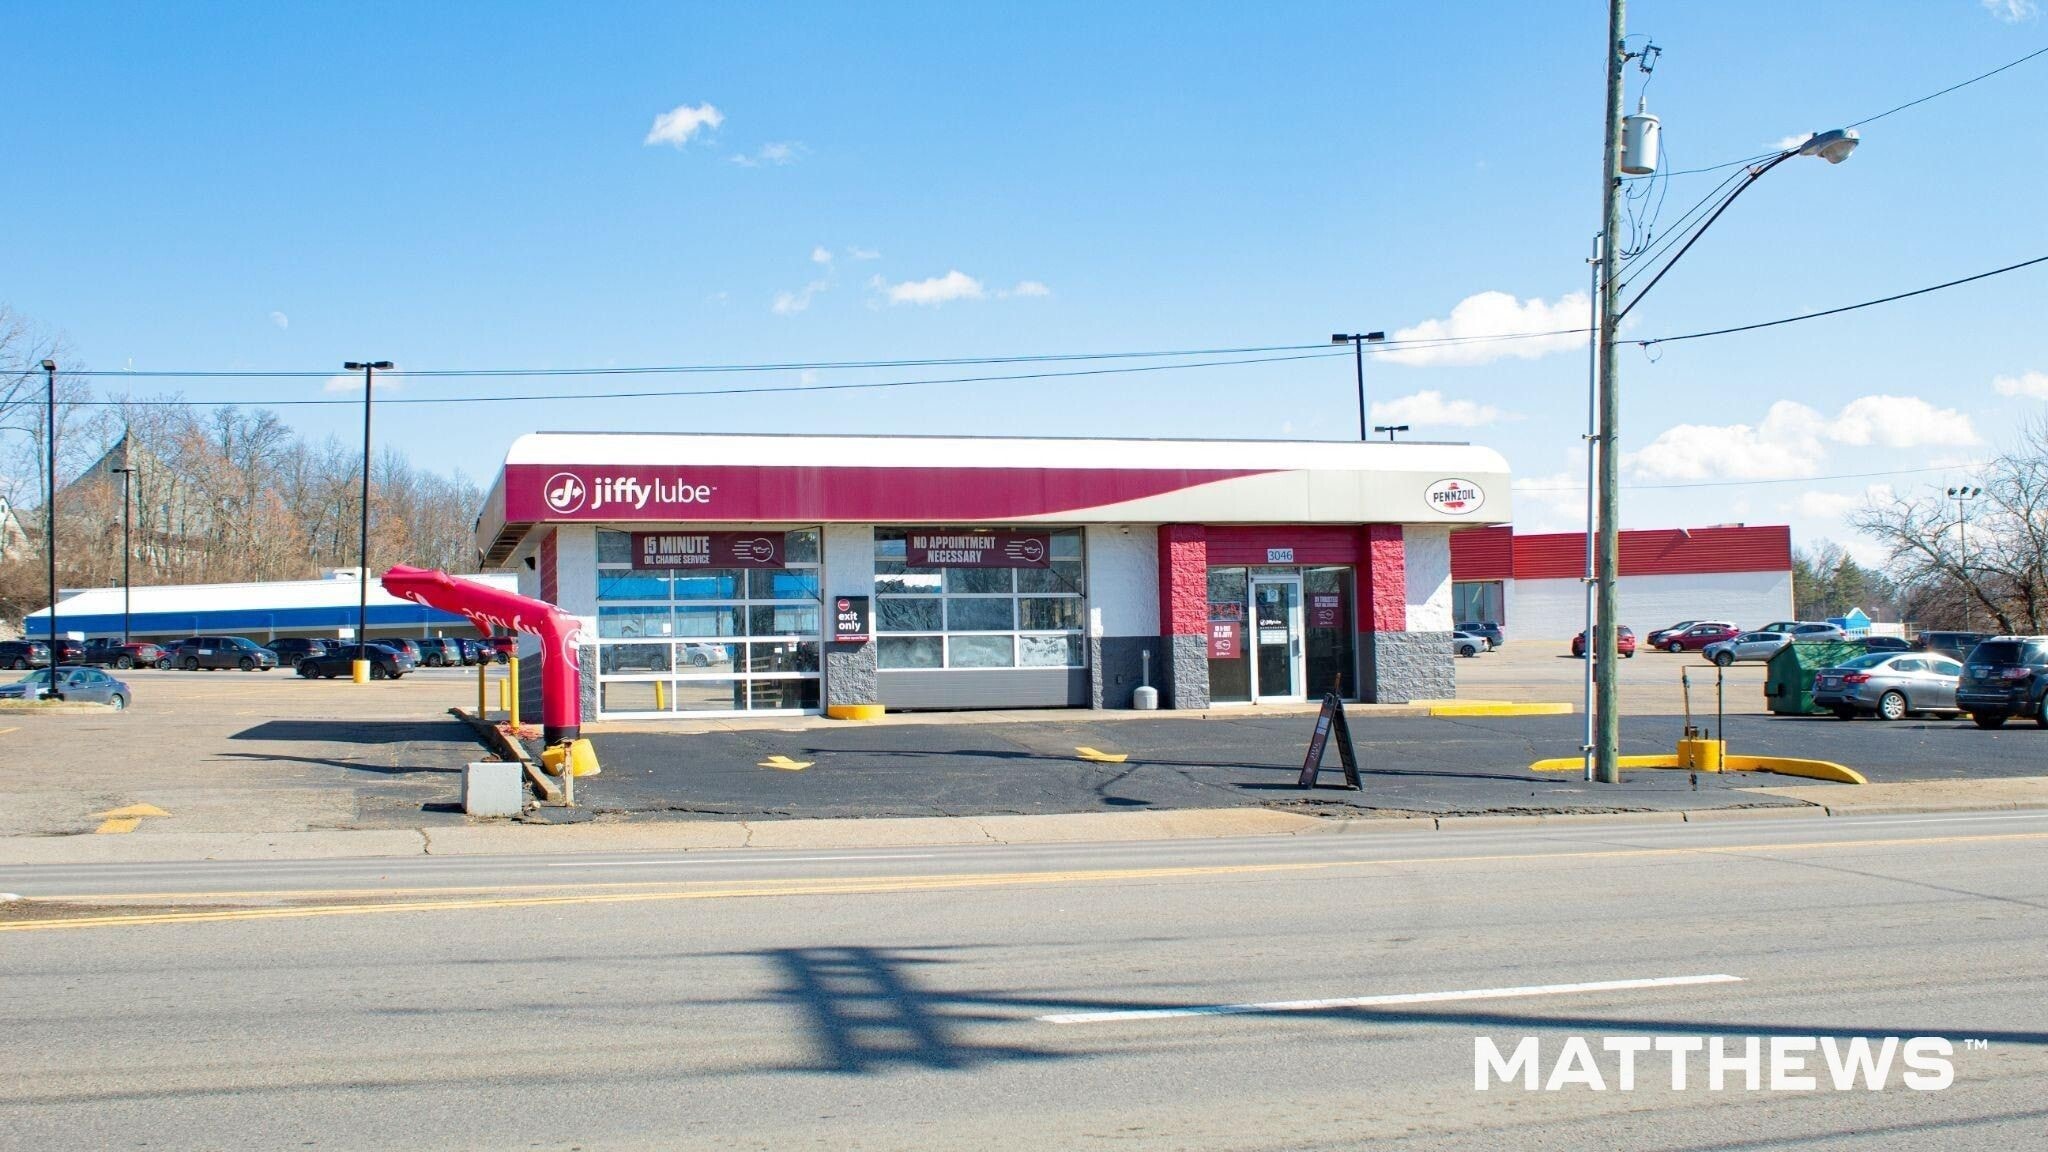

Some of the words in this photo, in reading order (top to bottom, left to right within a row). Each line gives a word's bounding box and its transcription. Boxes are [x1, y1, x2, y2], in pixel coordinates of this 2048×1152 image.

[1433, 489, 1476, 503] PENNZOIL
[643, 536, 657, 554] 15
[660, 536, 710, 554] MINUTE
[913, 536, 927, 549] NO
[929, 536, 996, 549] APPOINTMENT
[643, 555, 655, 565] OIL
[655, 555, 682, 564] CHANGE
[682, 554, 710, 564] SERVICE
[927, 550, 982, 563] NECESSARY
[1268, 550, 1293, 561] 3046
[838, 611, 858, 620] exit
[838, 620, 861, 632] only
